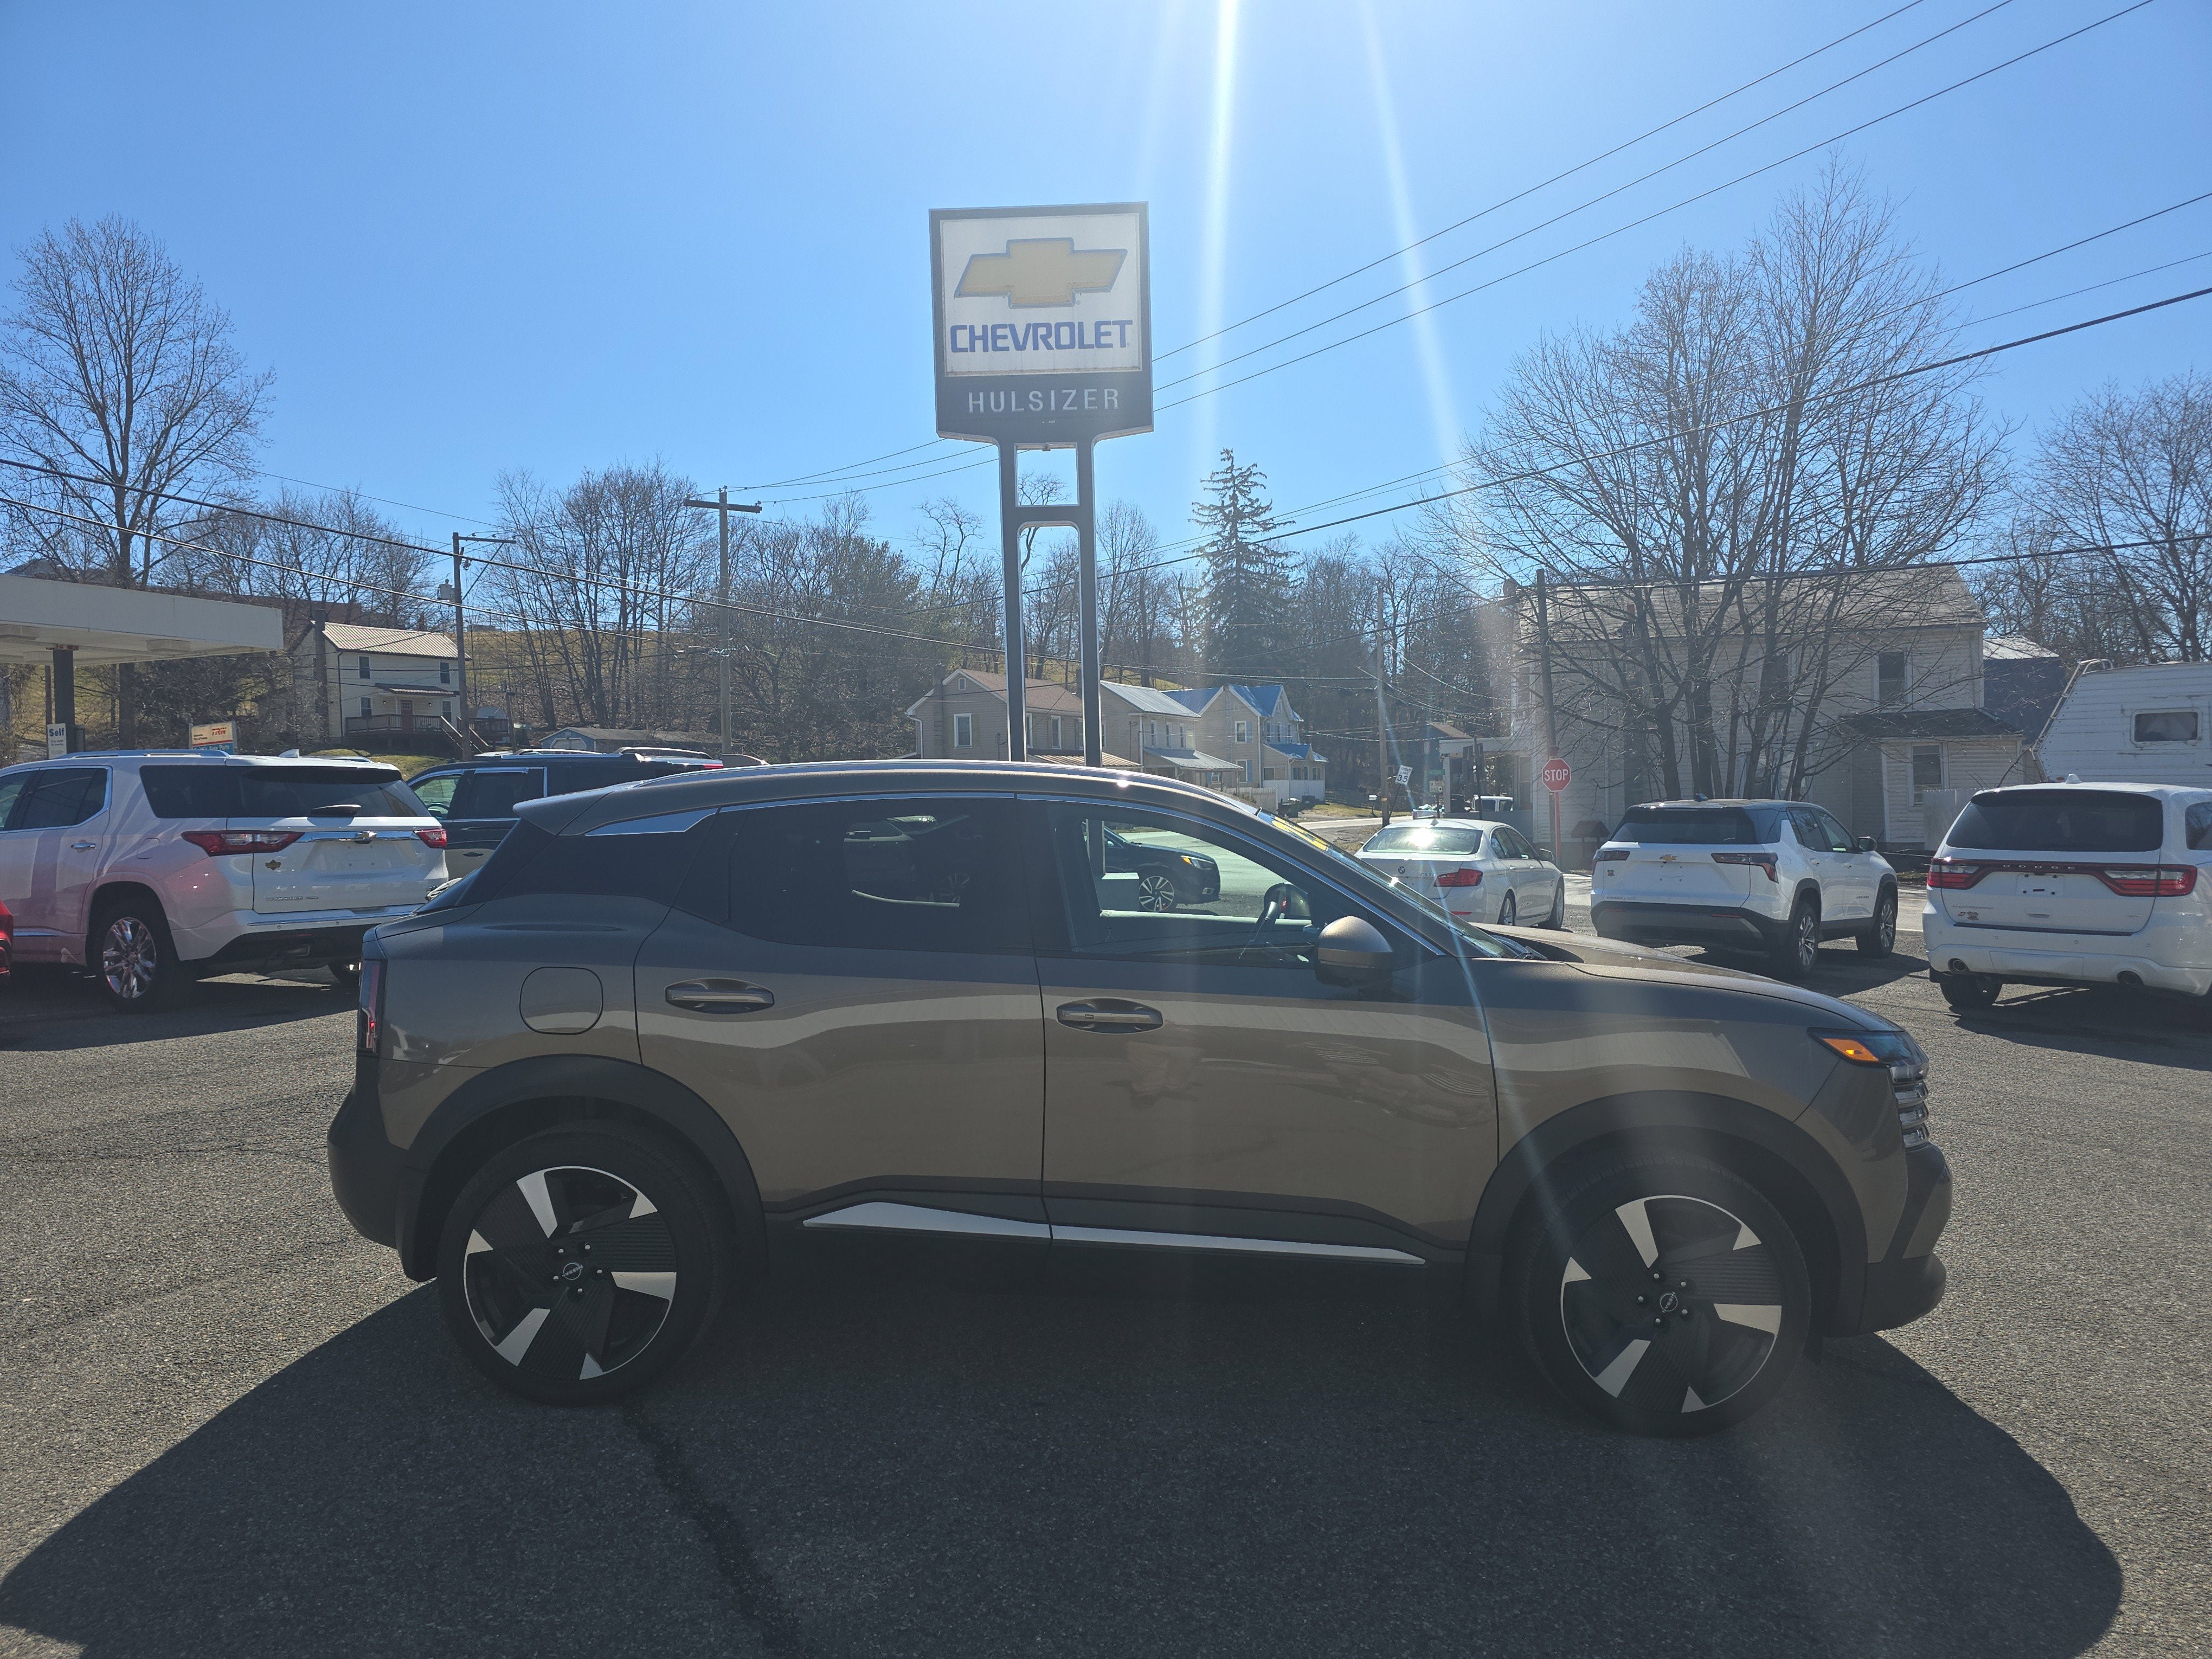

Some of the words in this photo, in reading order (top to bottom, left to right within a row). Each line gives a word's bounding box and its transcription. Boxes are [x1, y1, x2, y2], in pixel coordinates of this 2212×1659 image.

[950, 320, 1133, 353] CHEVROLET
[968, 388, 1120, 414] HULSIZER
[49, 728, 65, 737] Self
[211, 727, 227, 736] TRW
[1397, 774, 1409, 782] 35
[1544, 769, 1568, 781] STOP
[561, 1264, 583, 1278] NISSAN
